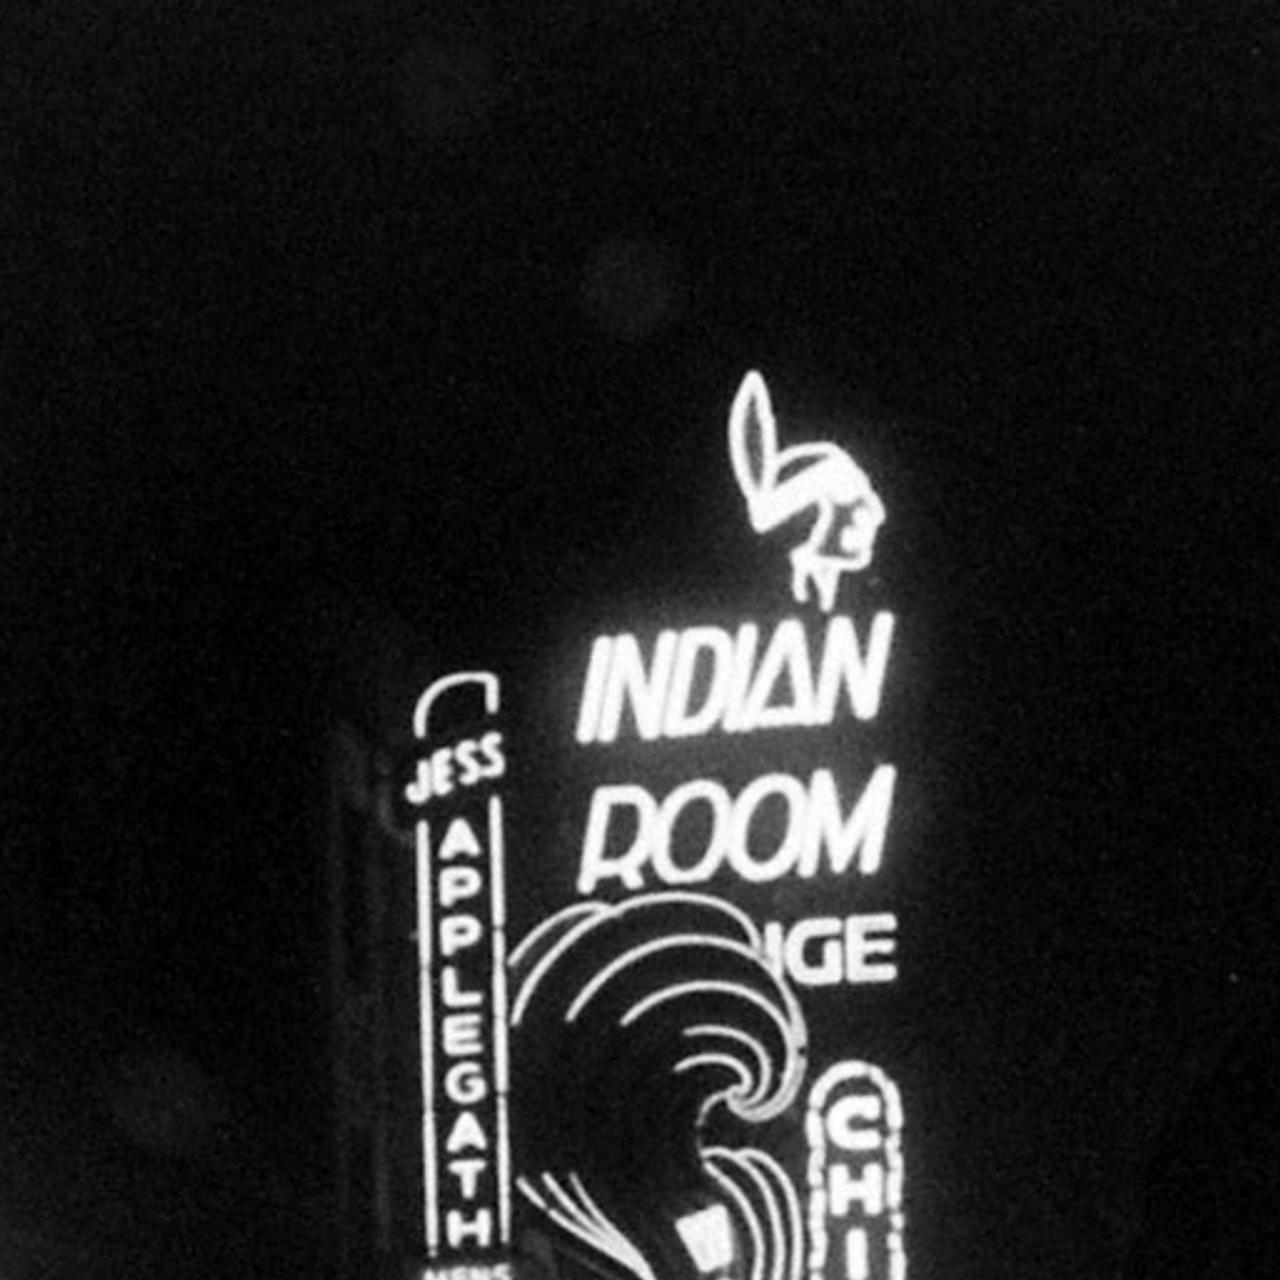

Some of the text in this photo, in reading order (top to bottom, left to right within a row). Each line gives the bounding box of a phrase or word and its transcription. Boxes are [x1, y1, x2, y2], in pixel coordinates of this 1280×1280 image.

[576, 611, 895, 744] INDIAN
[406, 732, 506, 803] JESS
[577, 764, 897, 894] ROOM
[438, 818, 492, 1247] APPLEGATH
